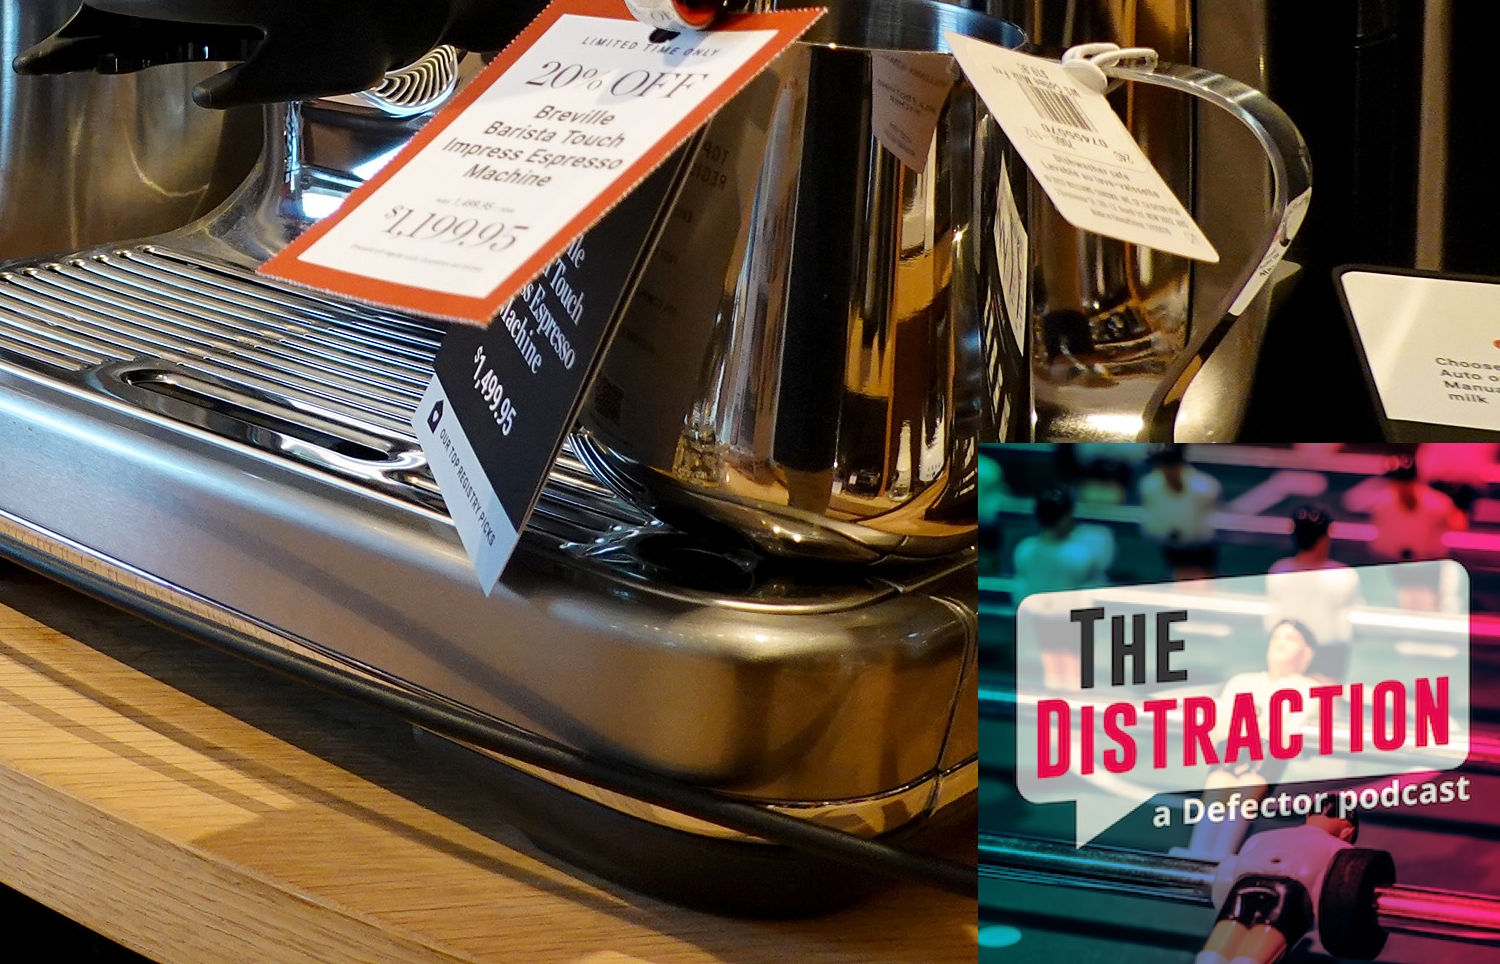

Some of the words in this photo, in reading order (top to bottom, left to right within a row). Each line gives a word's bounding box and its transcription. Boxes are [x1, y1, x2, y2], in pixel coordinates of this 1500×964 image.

[582, 36, 639, 50] LIMITED
[643, 43, 682, 56] TIME
[684, 48, 722, 57] ONLY
[525, 60, 609, 91] 20%
[610, 69, 709, 98] OFF
[534, 105, 616, 126] Breville
[483, 121, 558, 142] Barista
[560, 129, 626, 149] Touch
[443, 137, 524, 160] Impress
[525, 148, 624, 171] Espresso
[463, 164, 552, 187] Machine
[550, 257, 585, 327] Touch
[529, 283, 576, 370] Espresso
[1435, 357, 1500, 371] Choose
[1440, 369, 1482, 381] Auto
[474, 345, 518, 437] $1,499.95
[1444, 380, 1500, 394] Manua
[1447, 393, 1489, 404] milk
[439, 428, 452, 453] OUR
[449, 447, 460, 468] TOP
[456, 465, 481, 514] REGISTRY
[478, 511, 496, 548] PICKS
